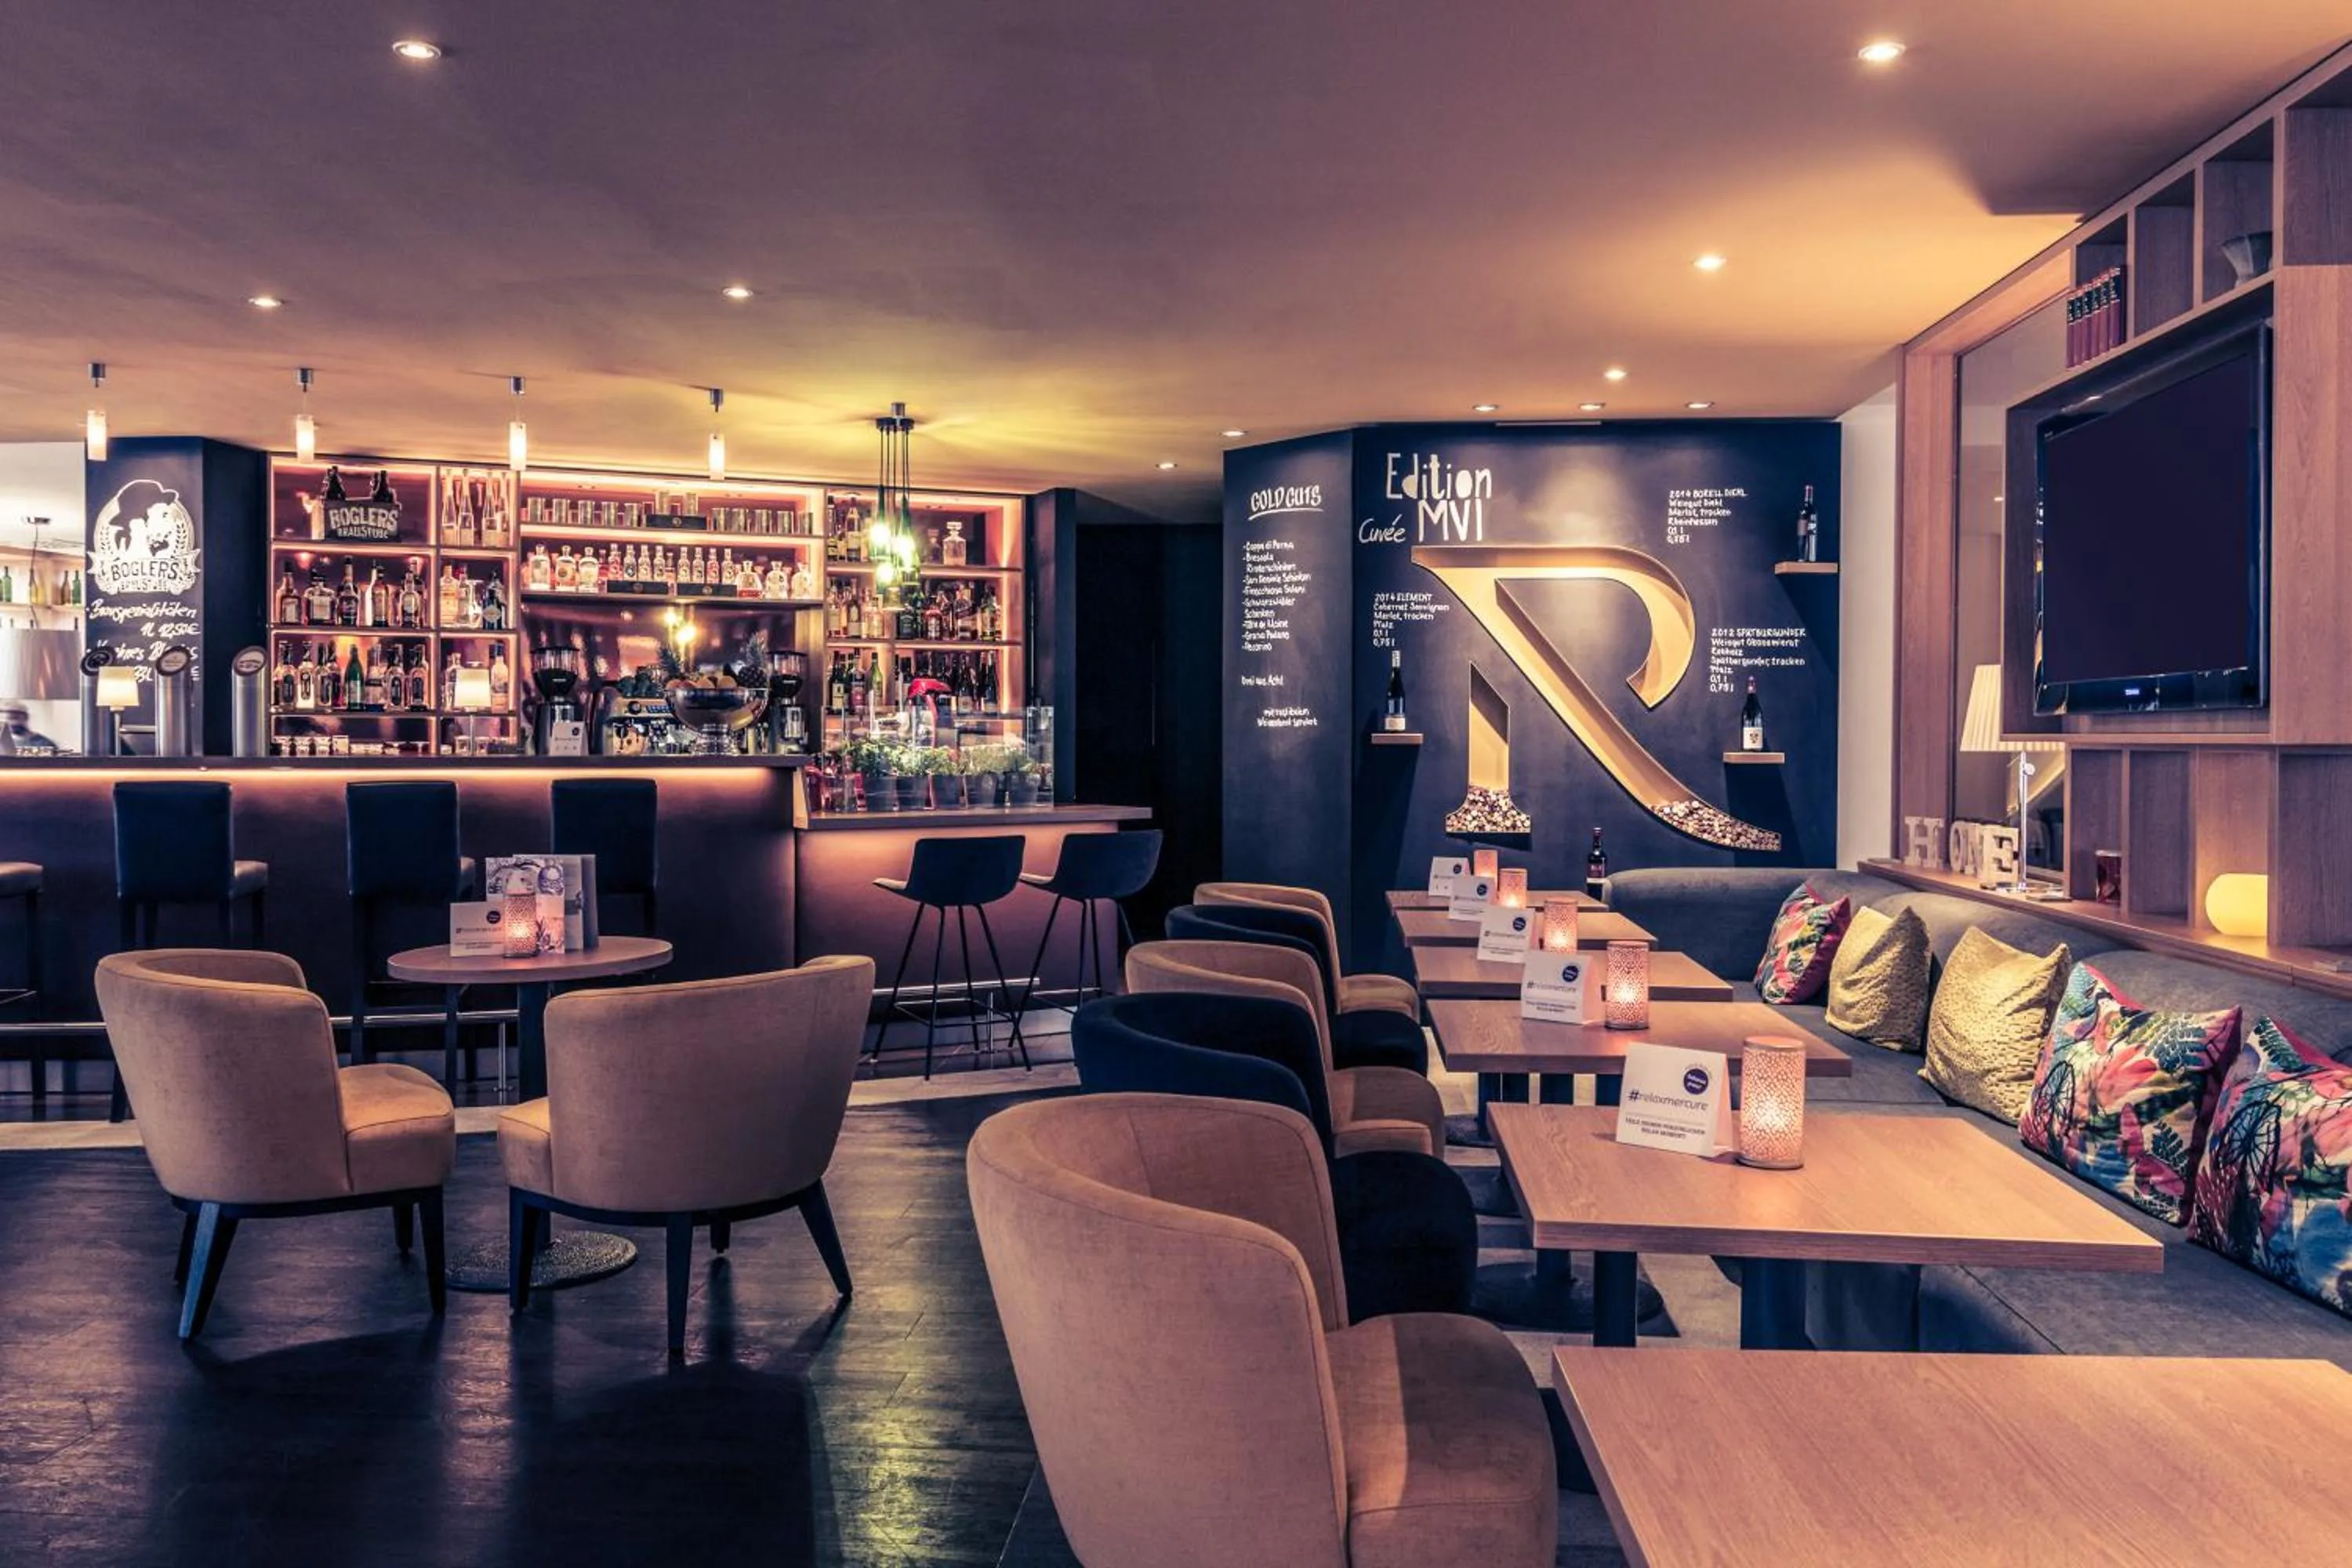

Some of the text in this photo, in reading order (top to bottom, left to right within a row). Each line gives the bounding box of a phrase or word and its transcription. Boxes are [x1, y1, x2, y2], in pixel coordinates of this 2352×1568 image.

[1386, 452, 1492, 499] Edition
[1250, 485, 1322, 512] COLD CUTS
[1358, 514, 1406, 543] Cuvée
[1418, 498, 1483, 543] MVI
[111, 561, 179, 581] BOGLERS
[1628, 1088, 1709, 1111] #relaxmercure
